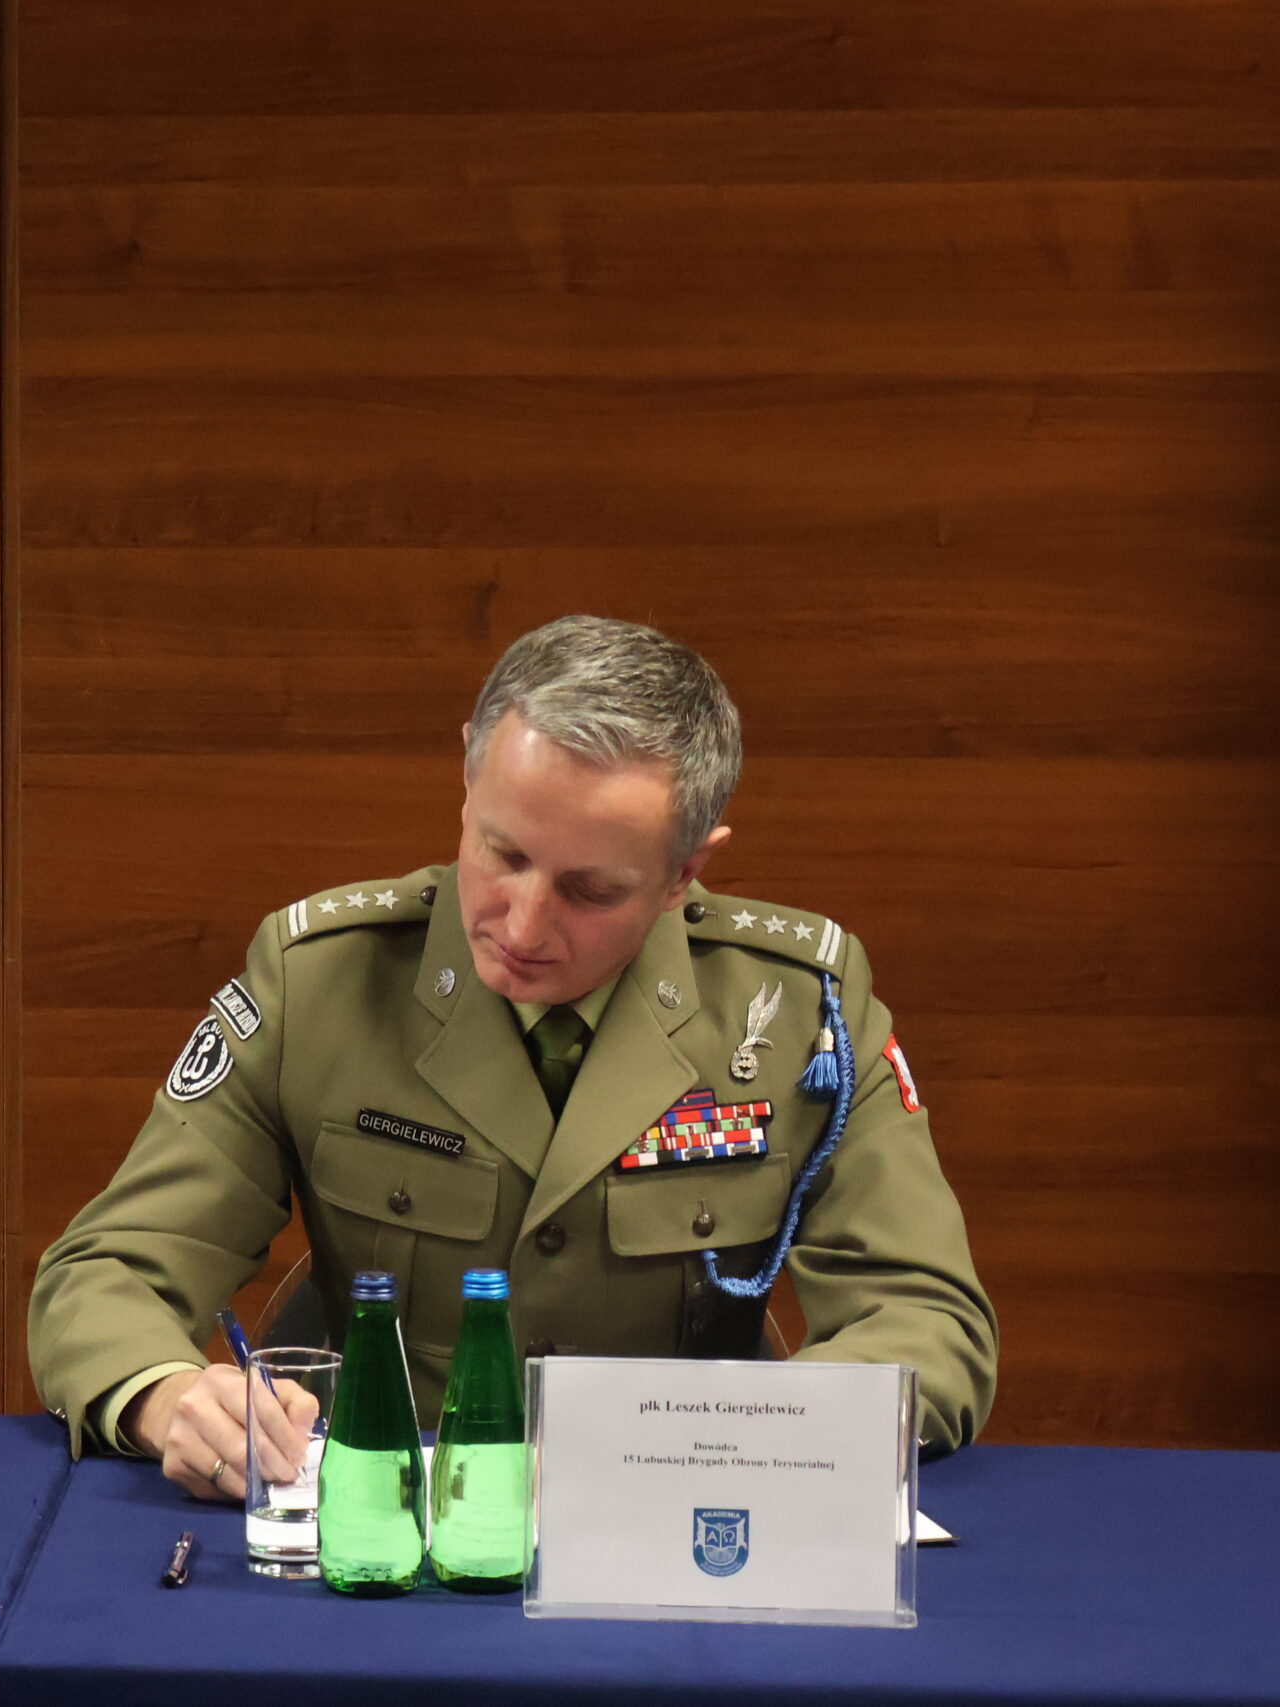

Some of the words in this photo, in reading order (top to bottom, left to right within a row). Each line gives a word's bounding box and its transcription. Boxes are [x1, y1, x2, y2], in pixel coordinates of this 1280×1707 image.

[359, 1113, 463, 1154] GIERGIELEWICZ
[666, 1400, 710, 1413] Leszek
[715, 1402, 806, 1416] Giergielewicz
[694, 1442, 738, 1452] Dowódca
[623, 1455, 634, 1464] 15
[637, 1455, 685, 1467] Lubuskiej
[688, 1456, 728, 1468] Brygady
[731, 1457, 768, 1469] Obrony
[773, 1458, 835, 1471] Terytorialnej
[702, 1511, 741, 1519] AKADEMIA
